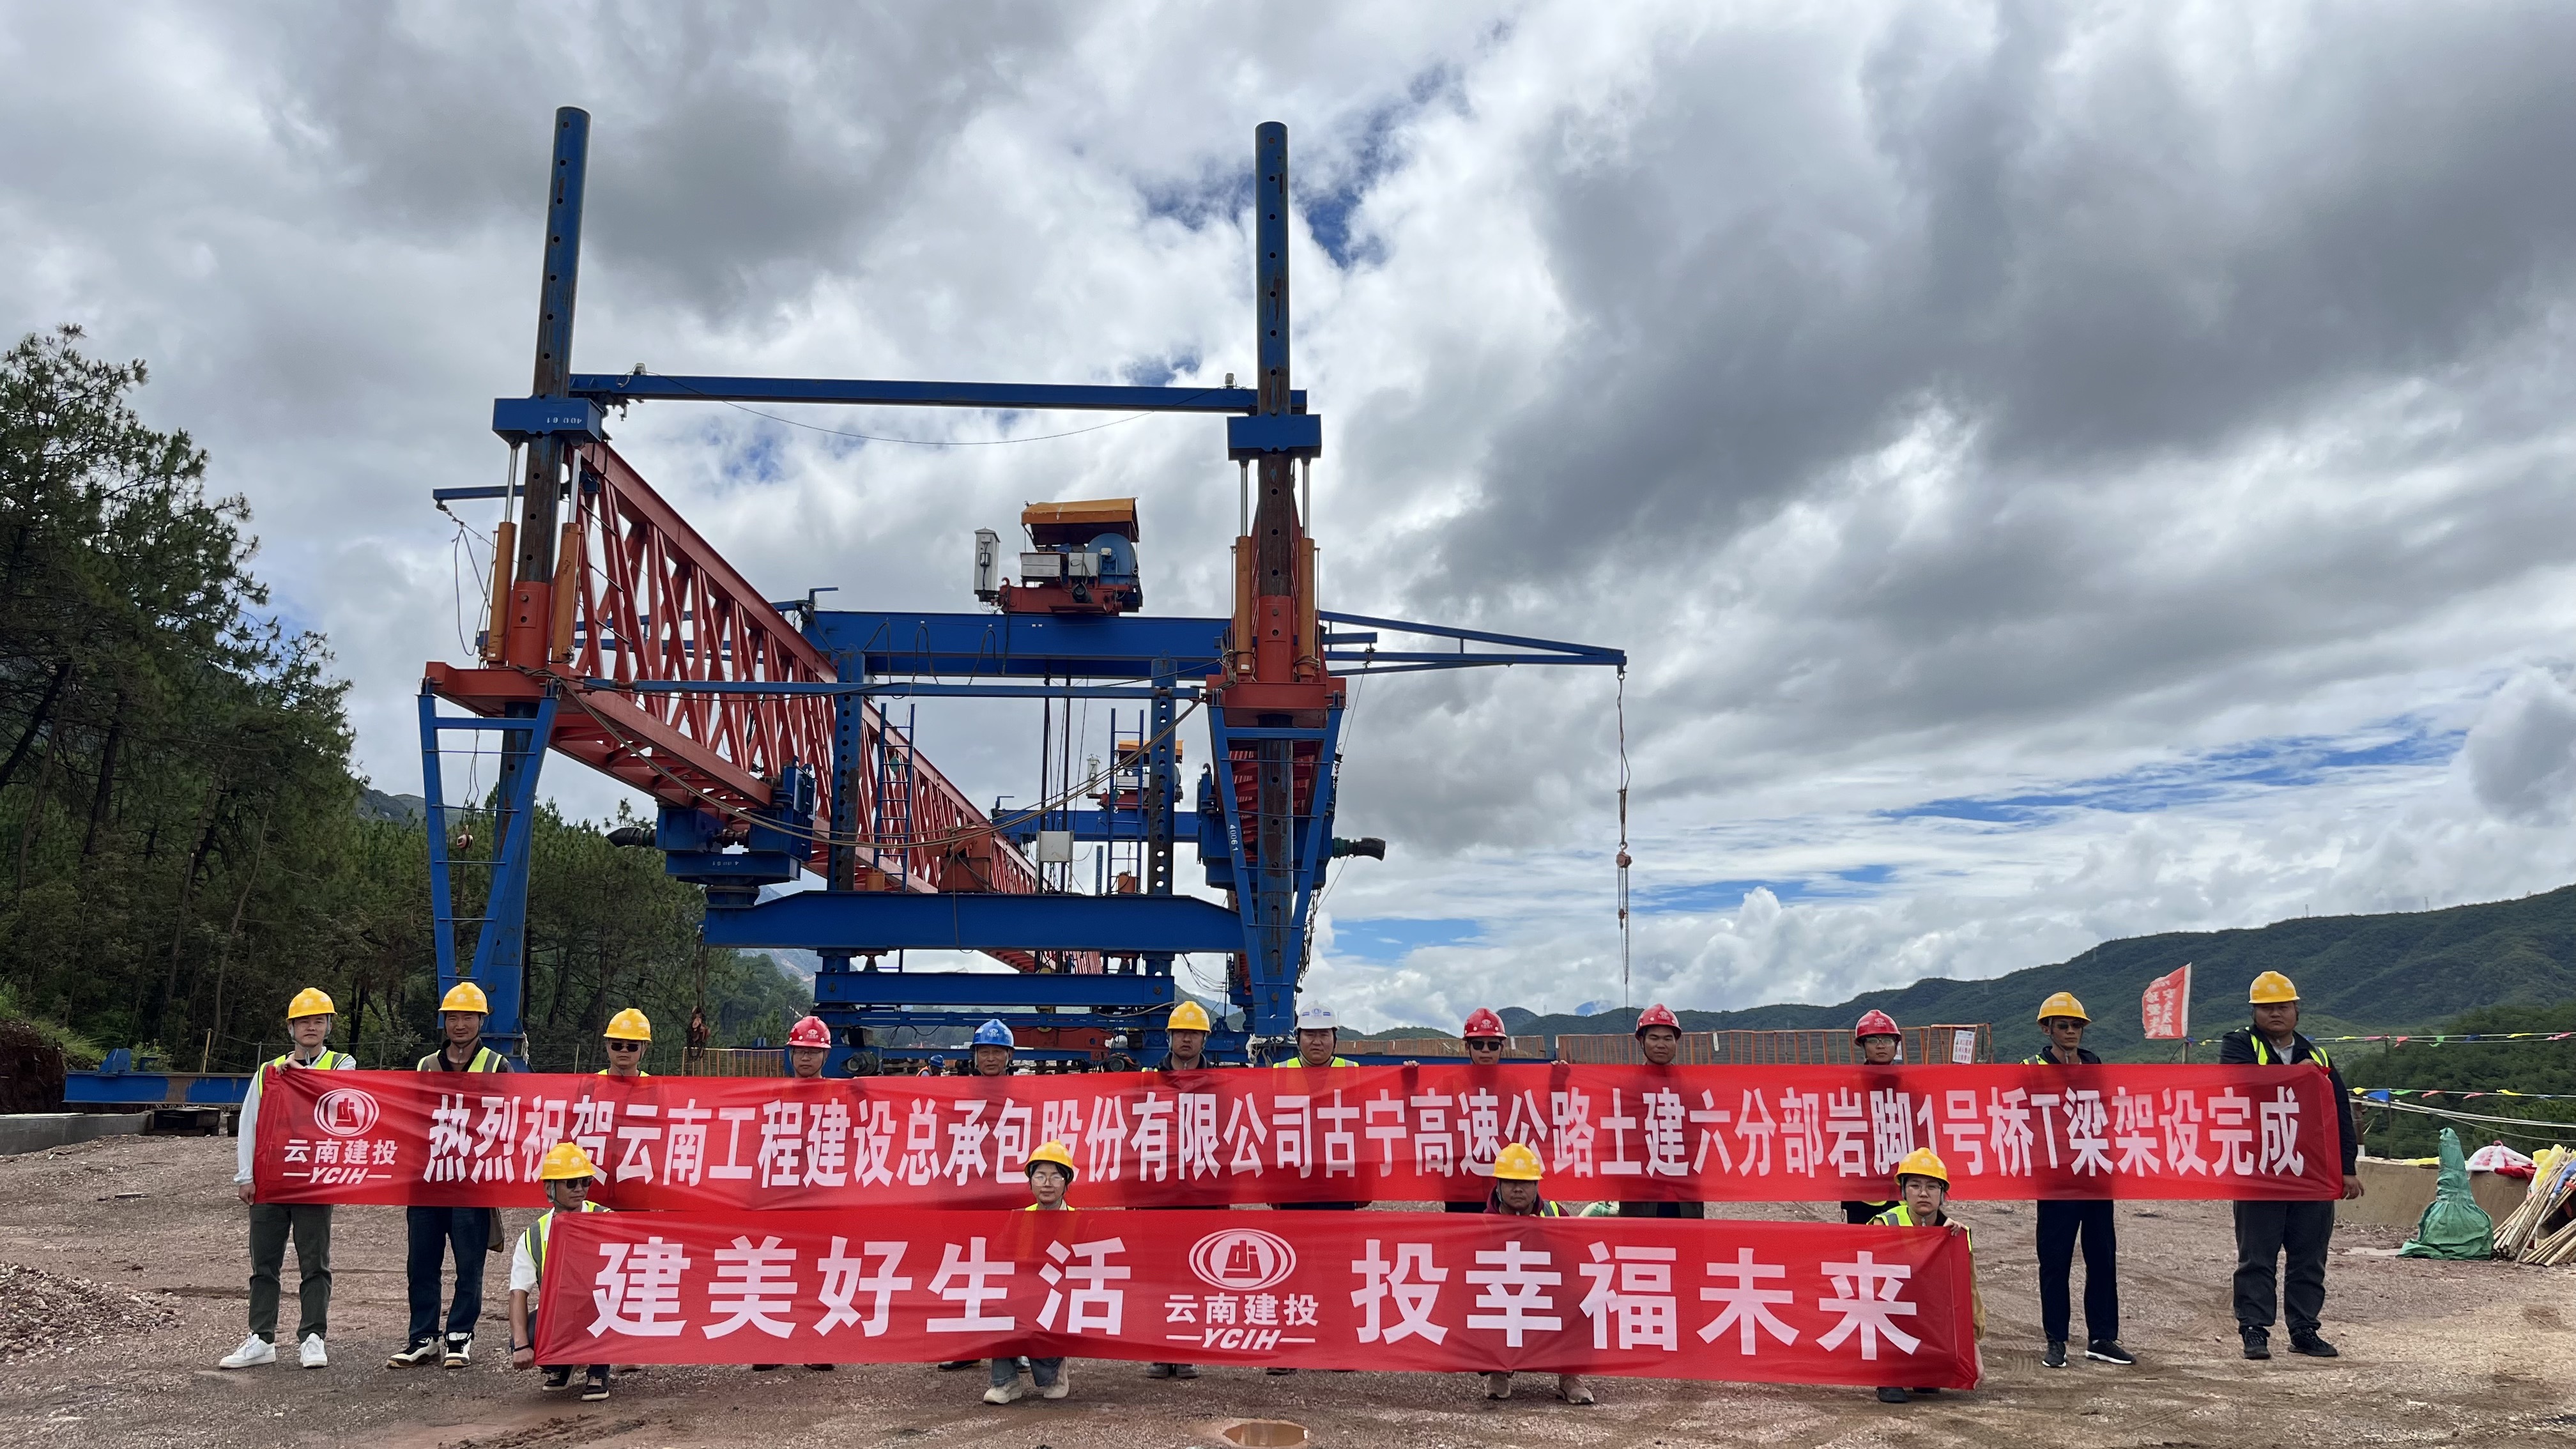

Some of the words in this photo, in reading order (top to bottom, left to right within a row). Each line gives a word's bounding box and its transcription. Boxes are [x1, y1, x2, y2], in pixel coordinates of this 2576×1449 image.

[284, 1138, 398, 1165] 云南建投
[309, 1167, 369, 1184] YCIH
[586, 1235, 1131, 1339] 建美好生活
[1351, 1239, 1921, 1361] 投幸福未来
[1165, 1292, 1319, 1326] 云南建投
[1202, 1328, 1282, 1351] YCIH
